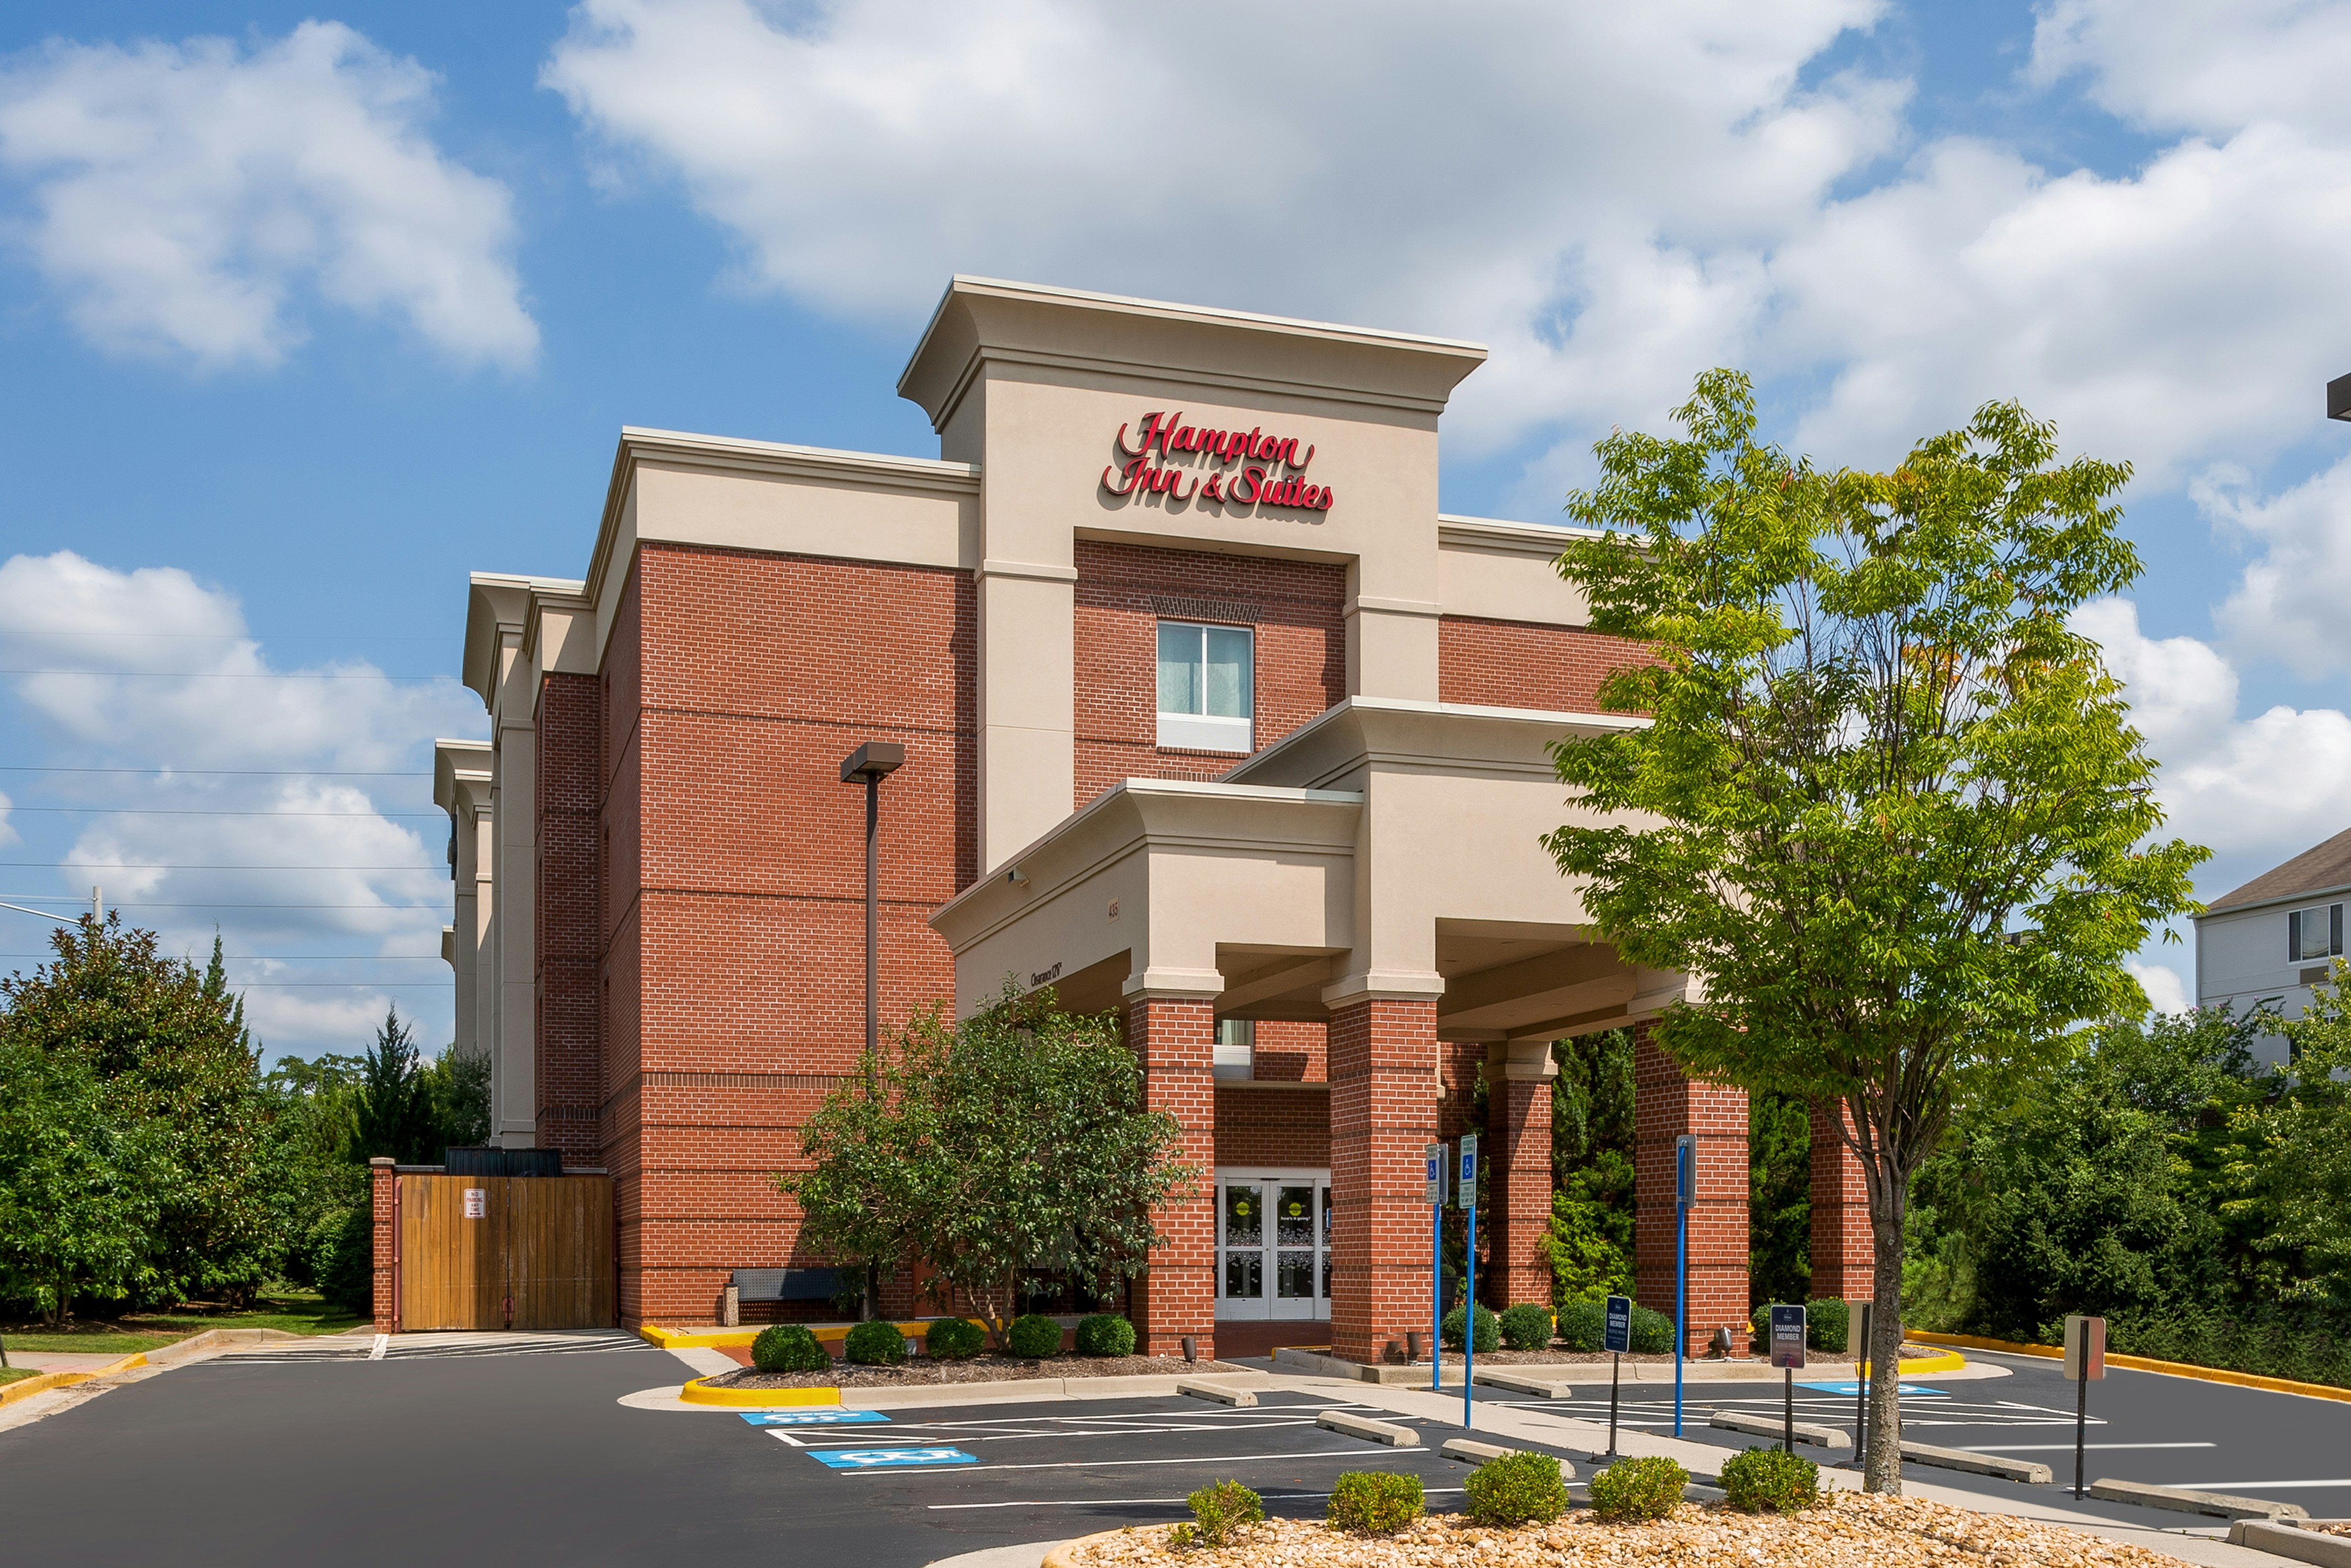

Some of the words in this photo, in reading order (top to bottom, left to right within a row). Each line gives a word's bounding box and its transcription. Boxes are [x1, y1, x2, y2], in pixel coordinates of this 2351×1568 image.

[1117, 411, 1315, 469] Hampton
[1102, 457, 1198, 501] Inn
[1202, 472, 1227, 504] &
[1228, 465, 1334, 510] Suites
[1609, 1312, 1627, 1321] DIAMOND
[1609, 1320, 1626, 1328] MEMBER
[1775, 1324, 1801, 1332] DIAMOND
[1777, 1332, 1800, 1341] MEMBER
